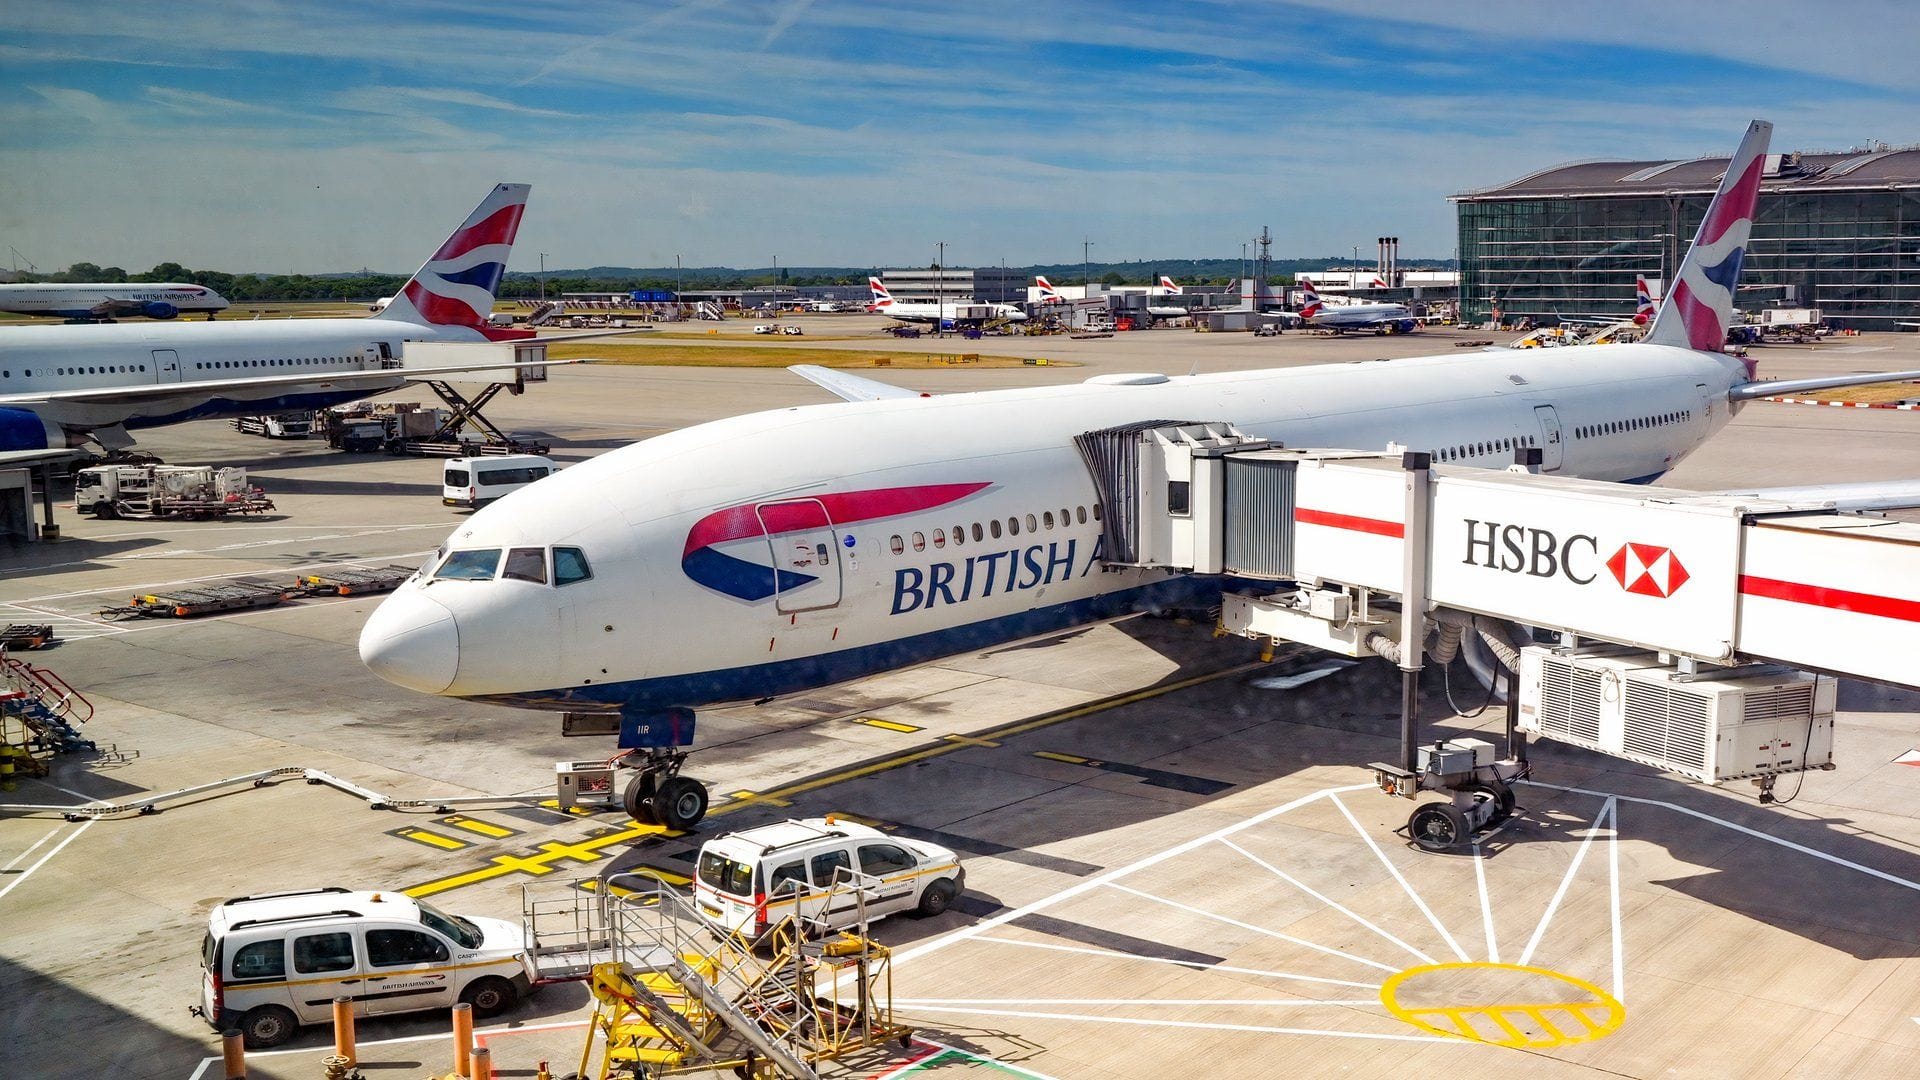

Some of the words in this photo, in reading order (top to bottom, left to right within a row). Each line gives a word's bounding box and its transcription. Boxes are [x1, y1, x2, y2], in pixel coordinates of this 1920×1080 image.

[164, 293, 196, 301] AIRWAYS
[889, 538, 1077, 616] BRITISH
[1462, 518, 1598, 585] HSBC
